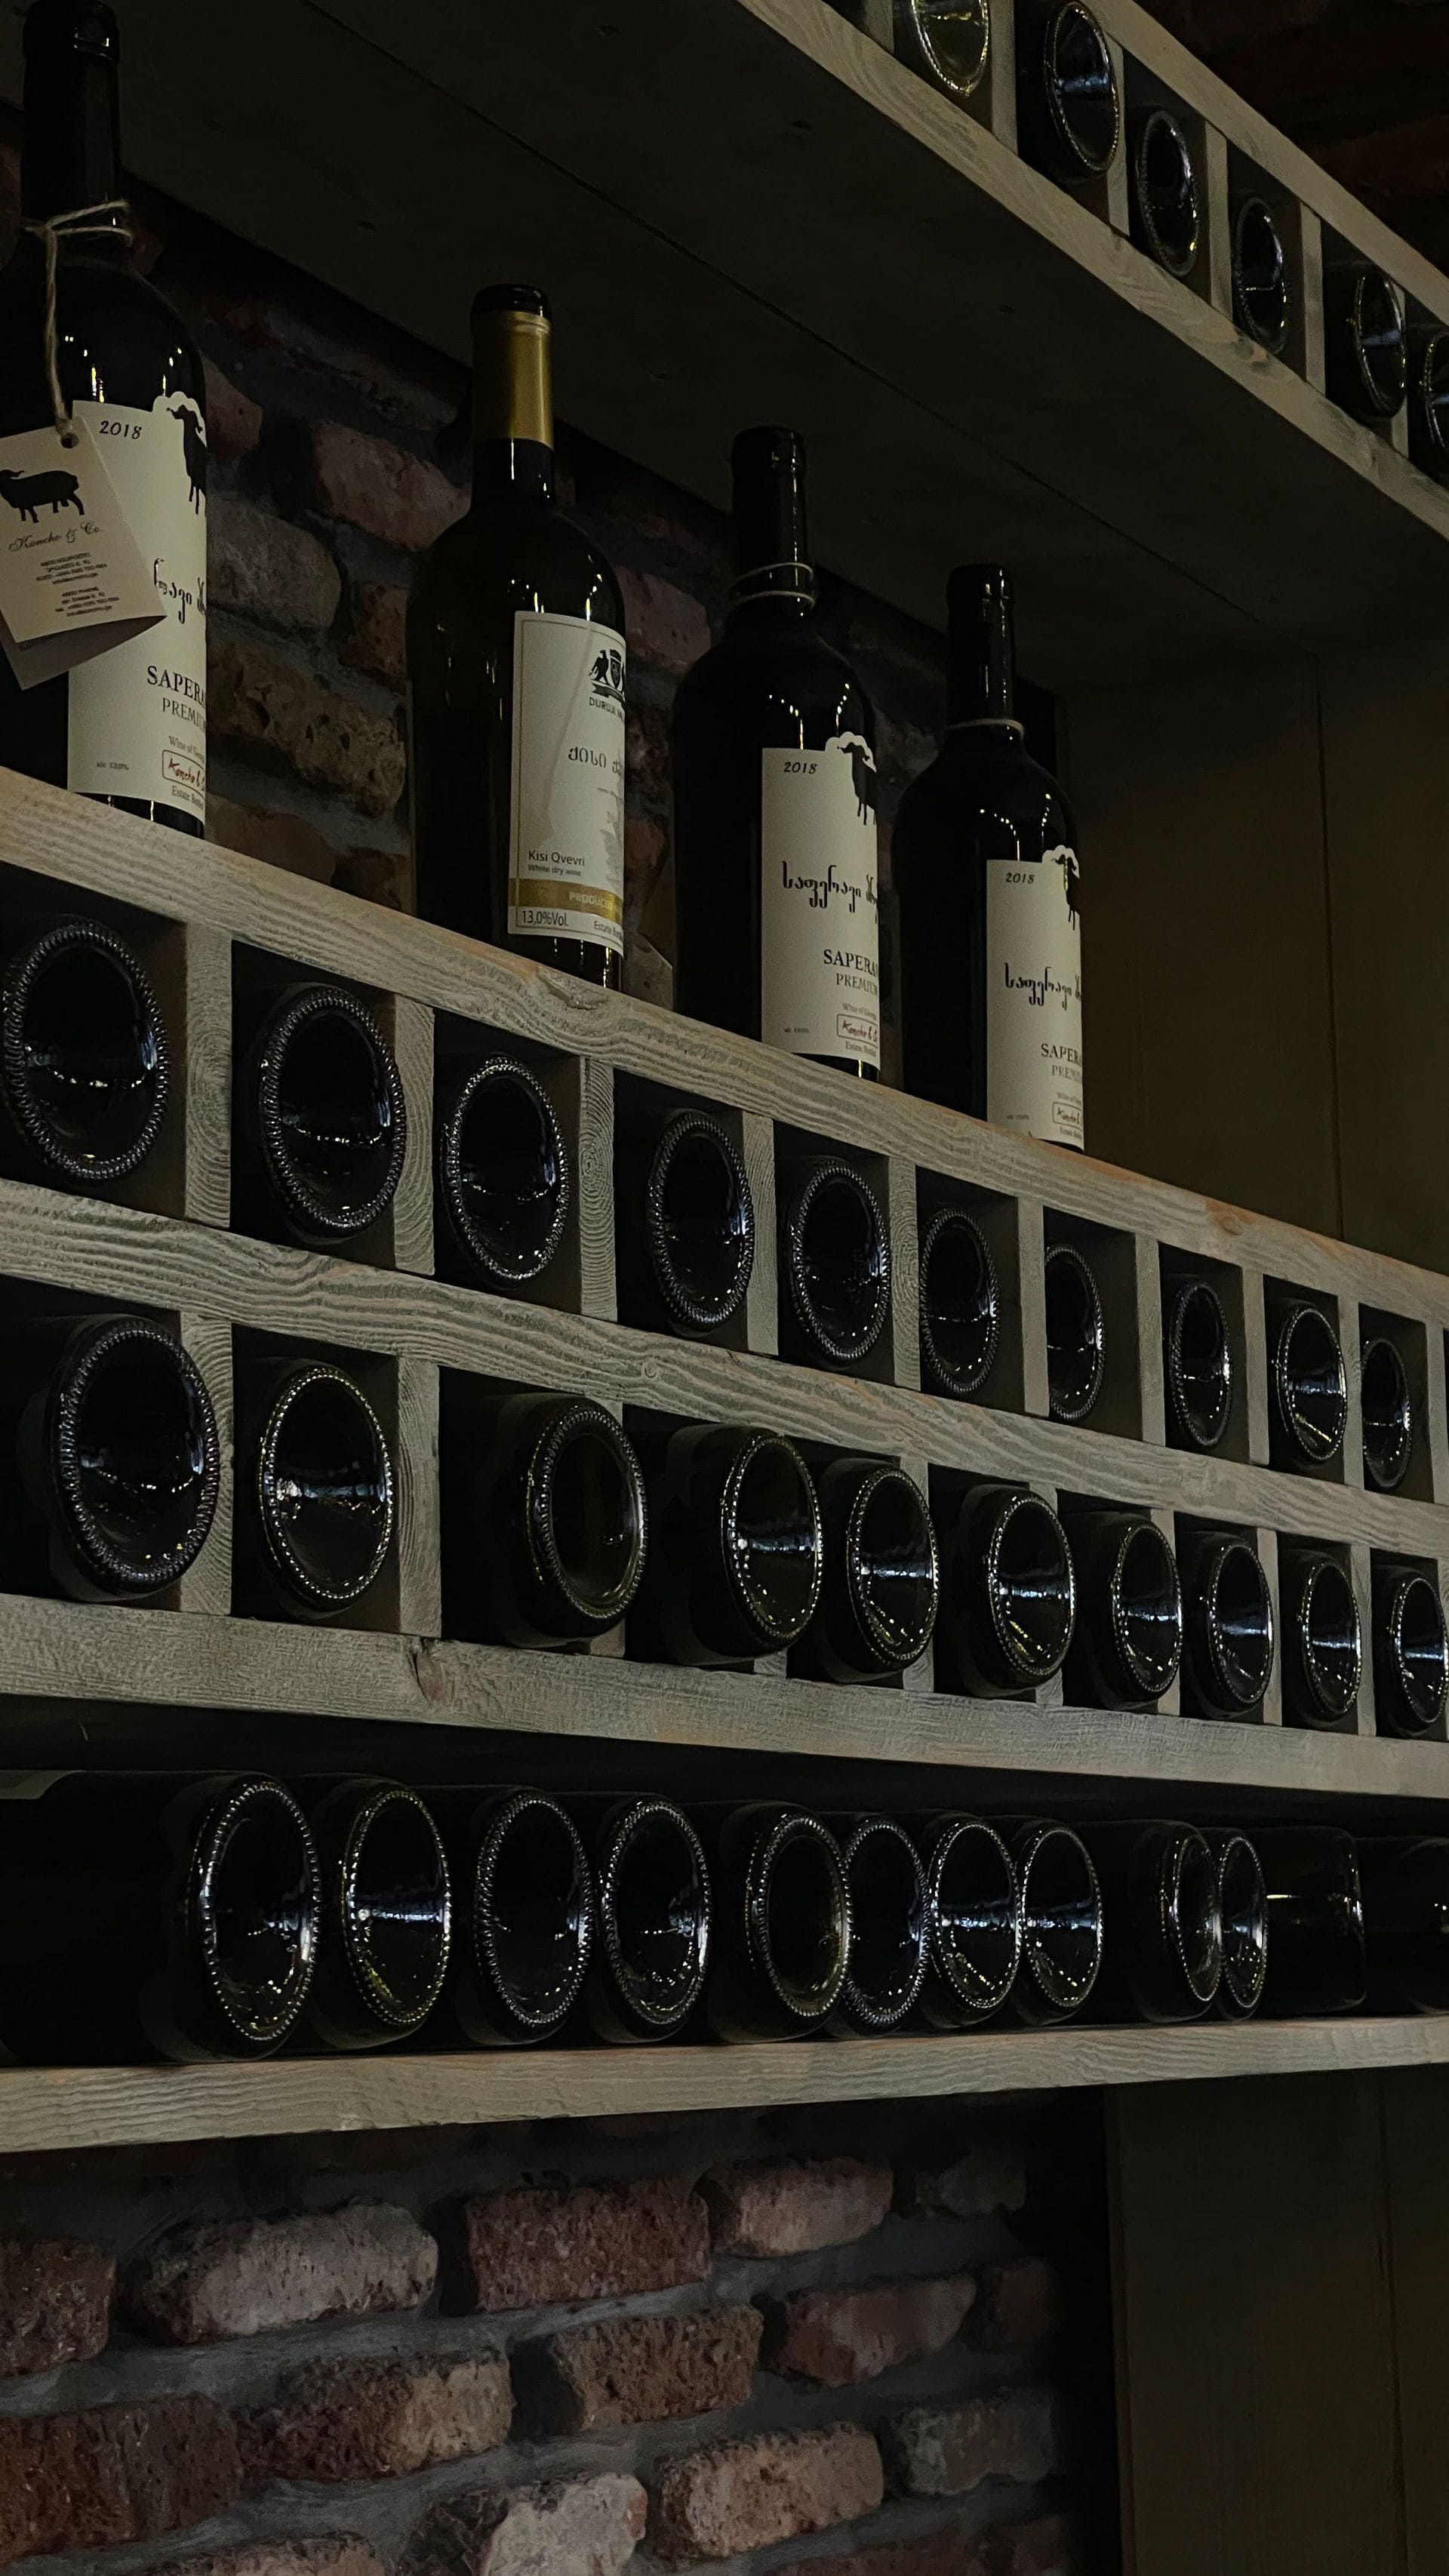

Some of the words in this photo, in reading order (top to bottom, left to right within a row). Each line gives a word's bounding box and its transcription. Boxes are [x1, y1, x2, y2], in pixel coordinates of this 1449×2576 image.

[99, 420, 143, 439] 2018
[147, 665, 205, 709] SAPERA
[783, 762, 817, 774] 2018
[528, 850, 548, 861] Kisi
[551, 851, 586, 866] Qvevri
[528, 863, 550, 873] White
[552, 866, 565, 876] dry
[565, 869, 582, 877] wine
[1006, 872, 1035, 884] 2018
[823, 948, 878, 978] SAPERA
[1041, 1043, 1081, 1066] SAPER
